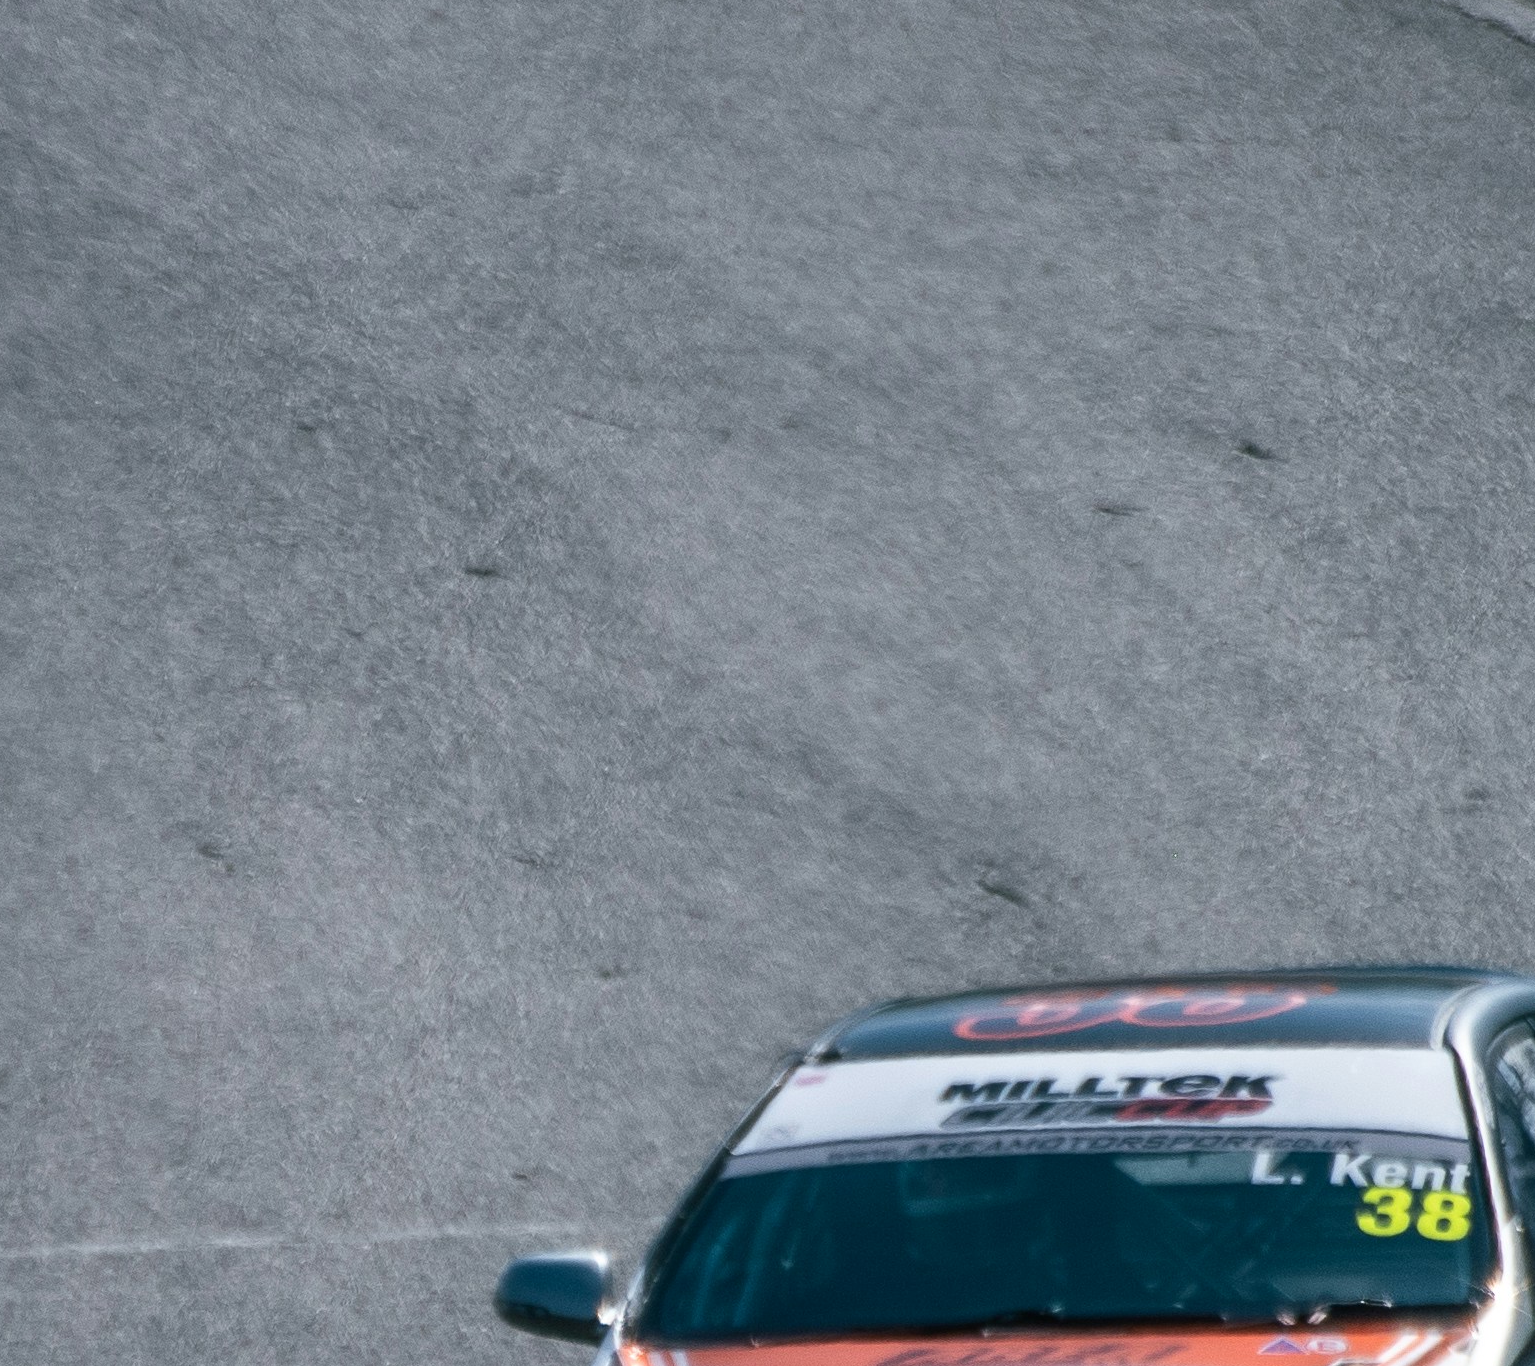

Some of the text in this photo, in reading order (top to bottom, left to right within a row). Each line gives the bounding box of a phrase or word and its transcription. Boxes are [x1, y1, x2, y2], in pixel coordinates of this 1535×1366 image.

[1251, 1151, 1470, 1194] L. Kent
[1356, 1188, 1471, 1241] 38
